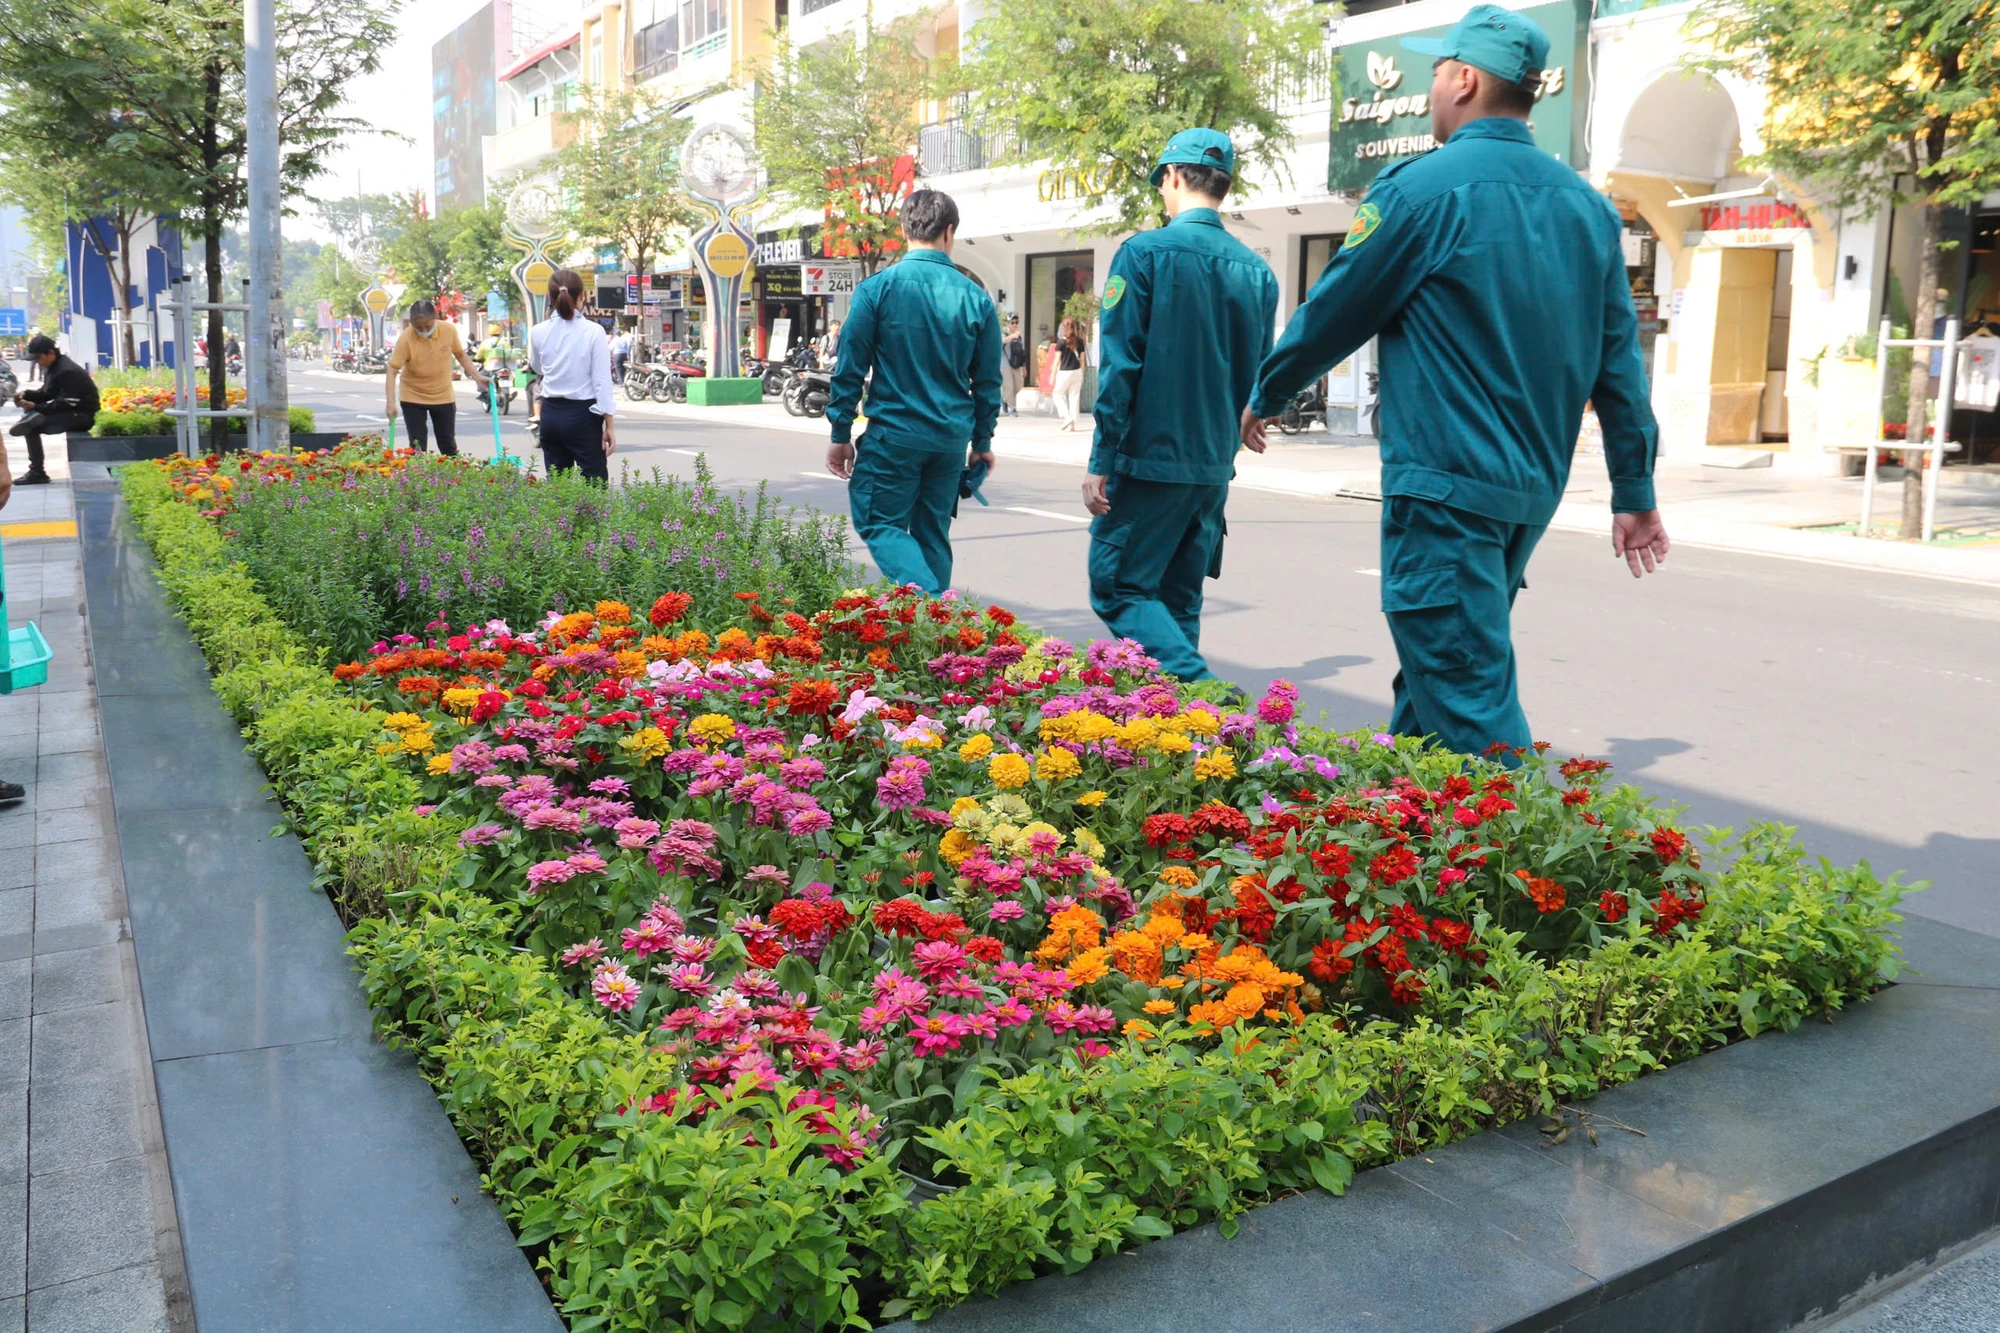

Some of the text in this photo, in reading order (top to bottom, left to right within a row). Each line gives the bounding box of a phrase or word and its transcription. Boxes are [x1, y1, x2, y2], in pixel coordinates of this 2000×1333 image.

[1338, 91, 1429, 124] Saigon
[828, 272, 853, 280] STORE
[767, 282, 782, 293] XQ
[828, 280, 853, 292] 24H
